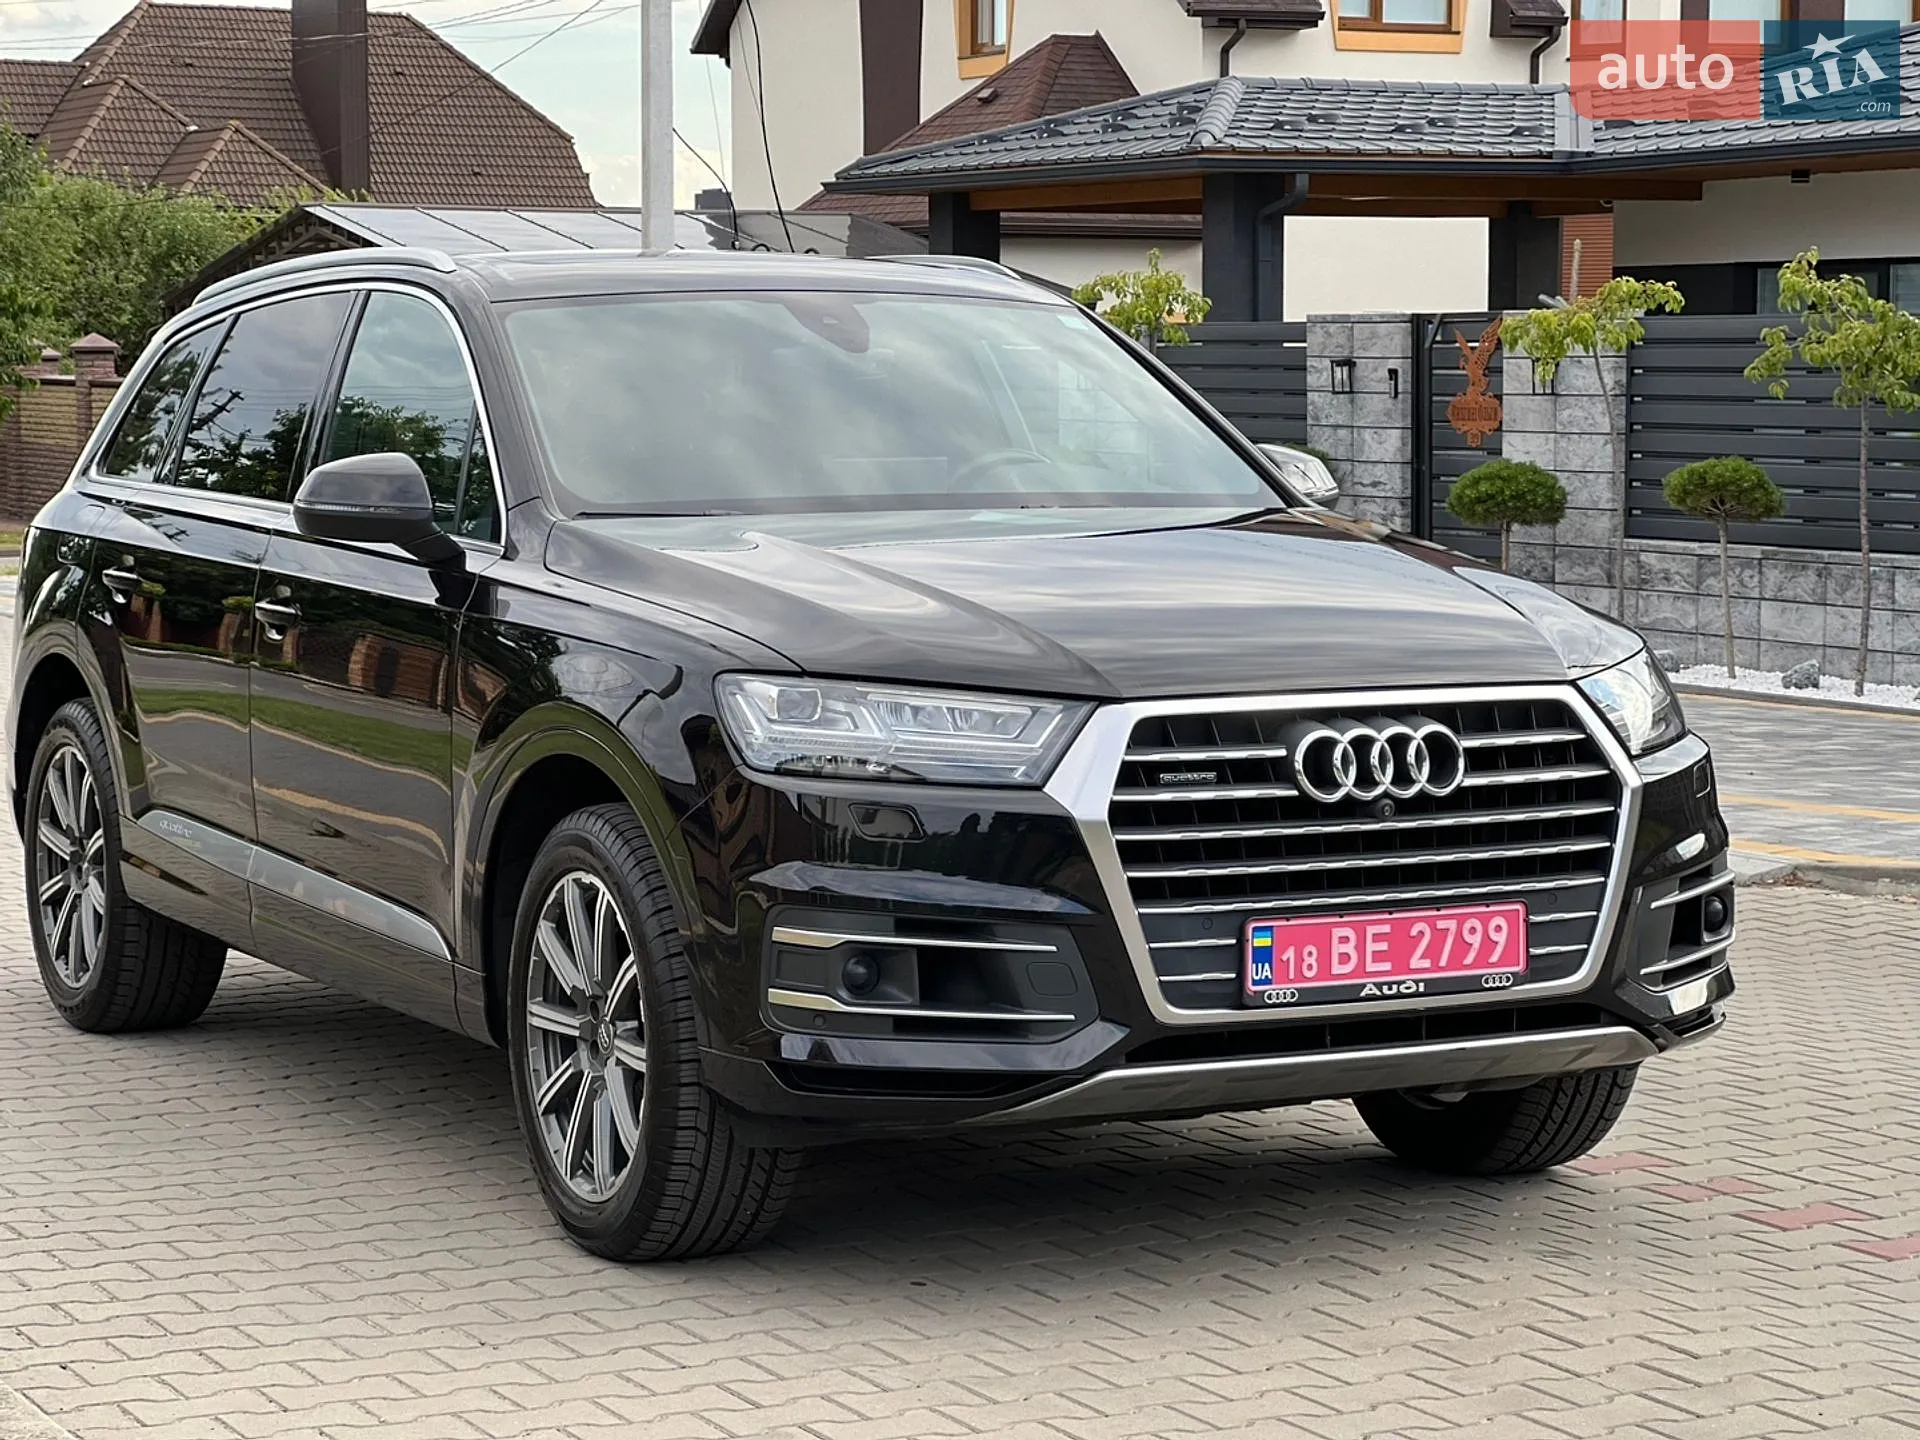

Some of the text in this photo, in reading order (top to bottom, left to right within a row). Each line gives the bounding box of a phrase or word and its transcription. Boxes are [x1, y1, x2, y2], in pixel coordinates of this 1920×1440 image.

[1280, 915, 1509, 980] 18 BE 2799
[1252, 963, 1272, 980] UA
[1359, 981, 1425, 997] Audi
